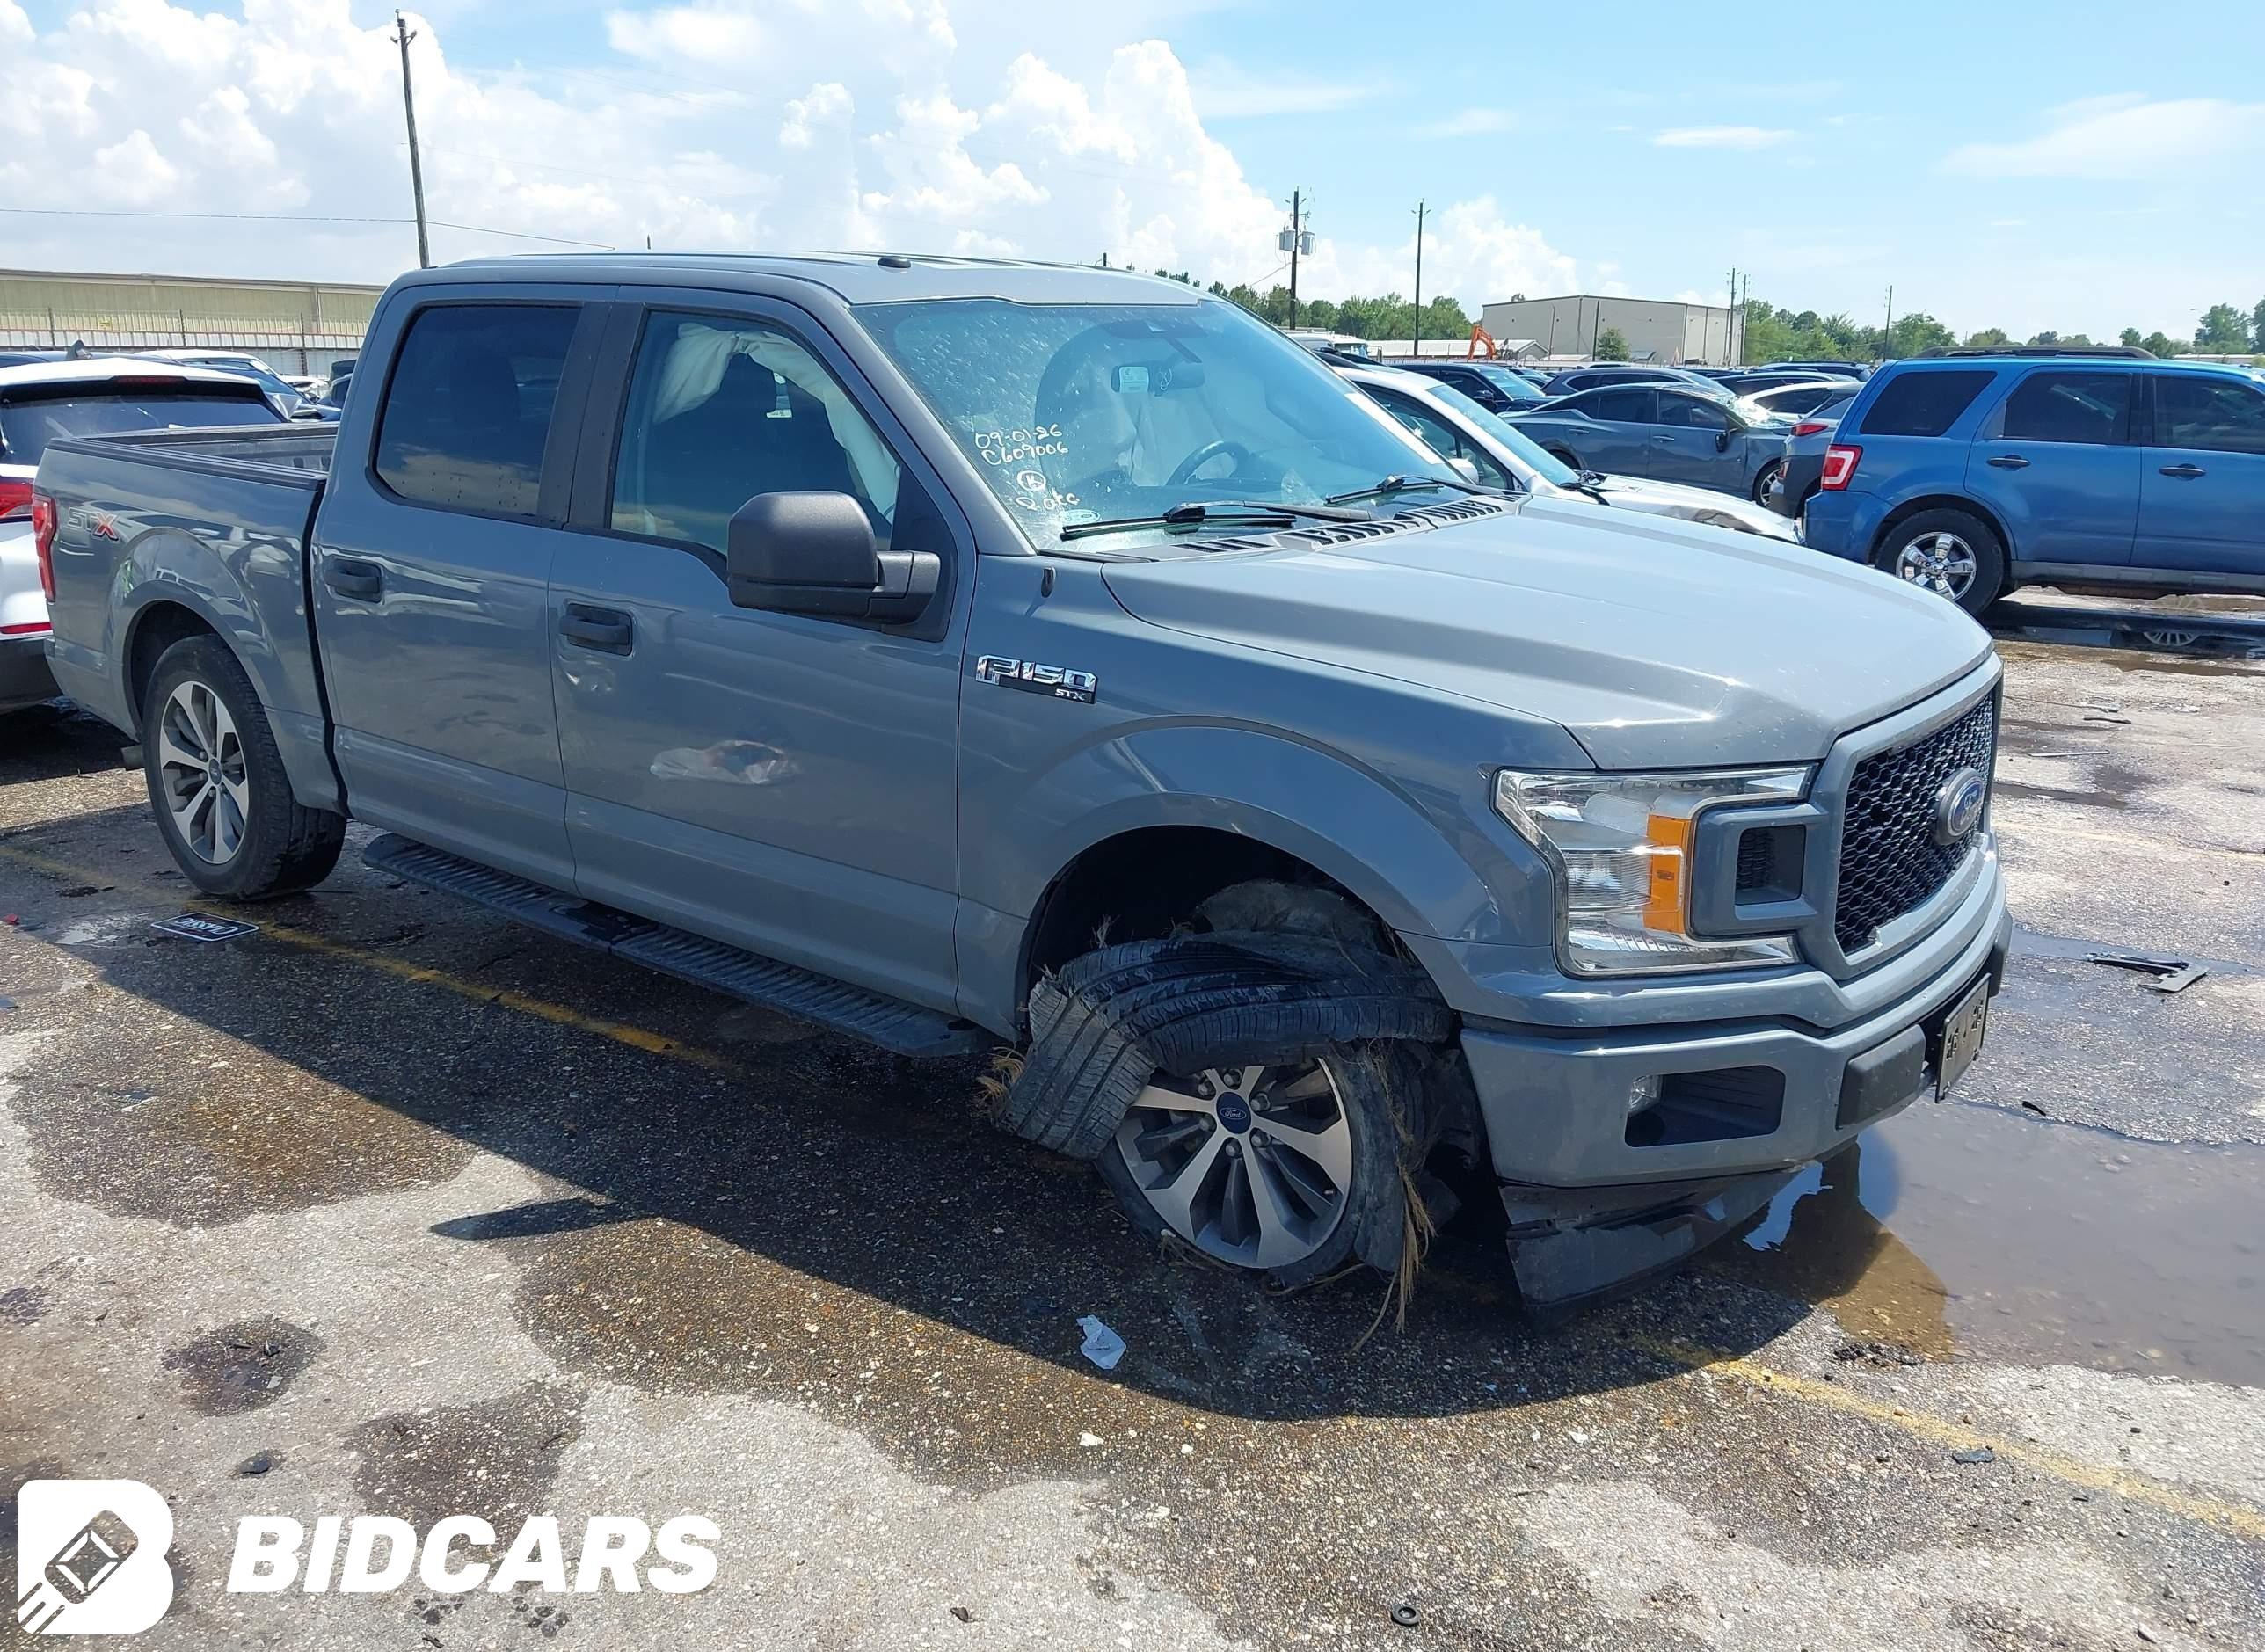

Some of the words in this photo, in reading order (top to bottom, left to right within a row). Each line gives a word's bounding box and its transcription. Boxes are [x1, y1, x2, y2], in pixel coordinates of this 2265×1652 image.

[69, 507, 119, 541] STX
[1055, 688, 1085, 702] STX
[1223, 1108, 1242, 1118] Ford
